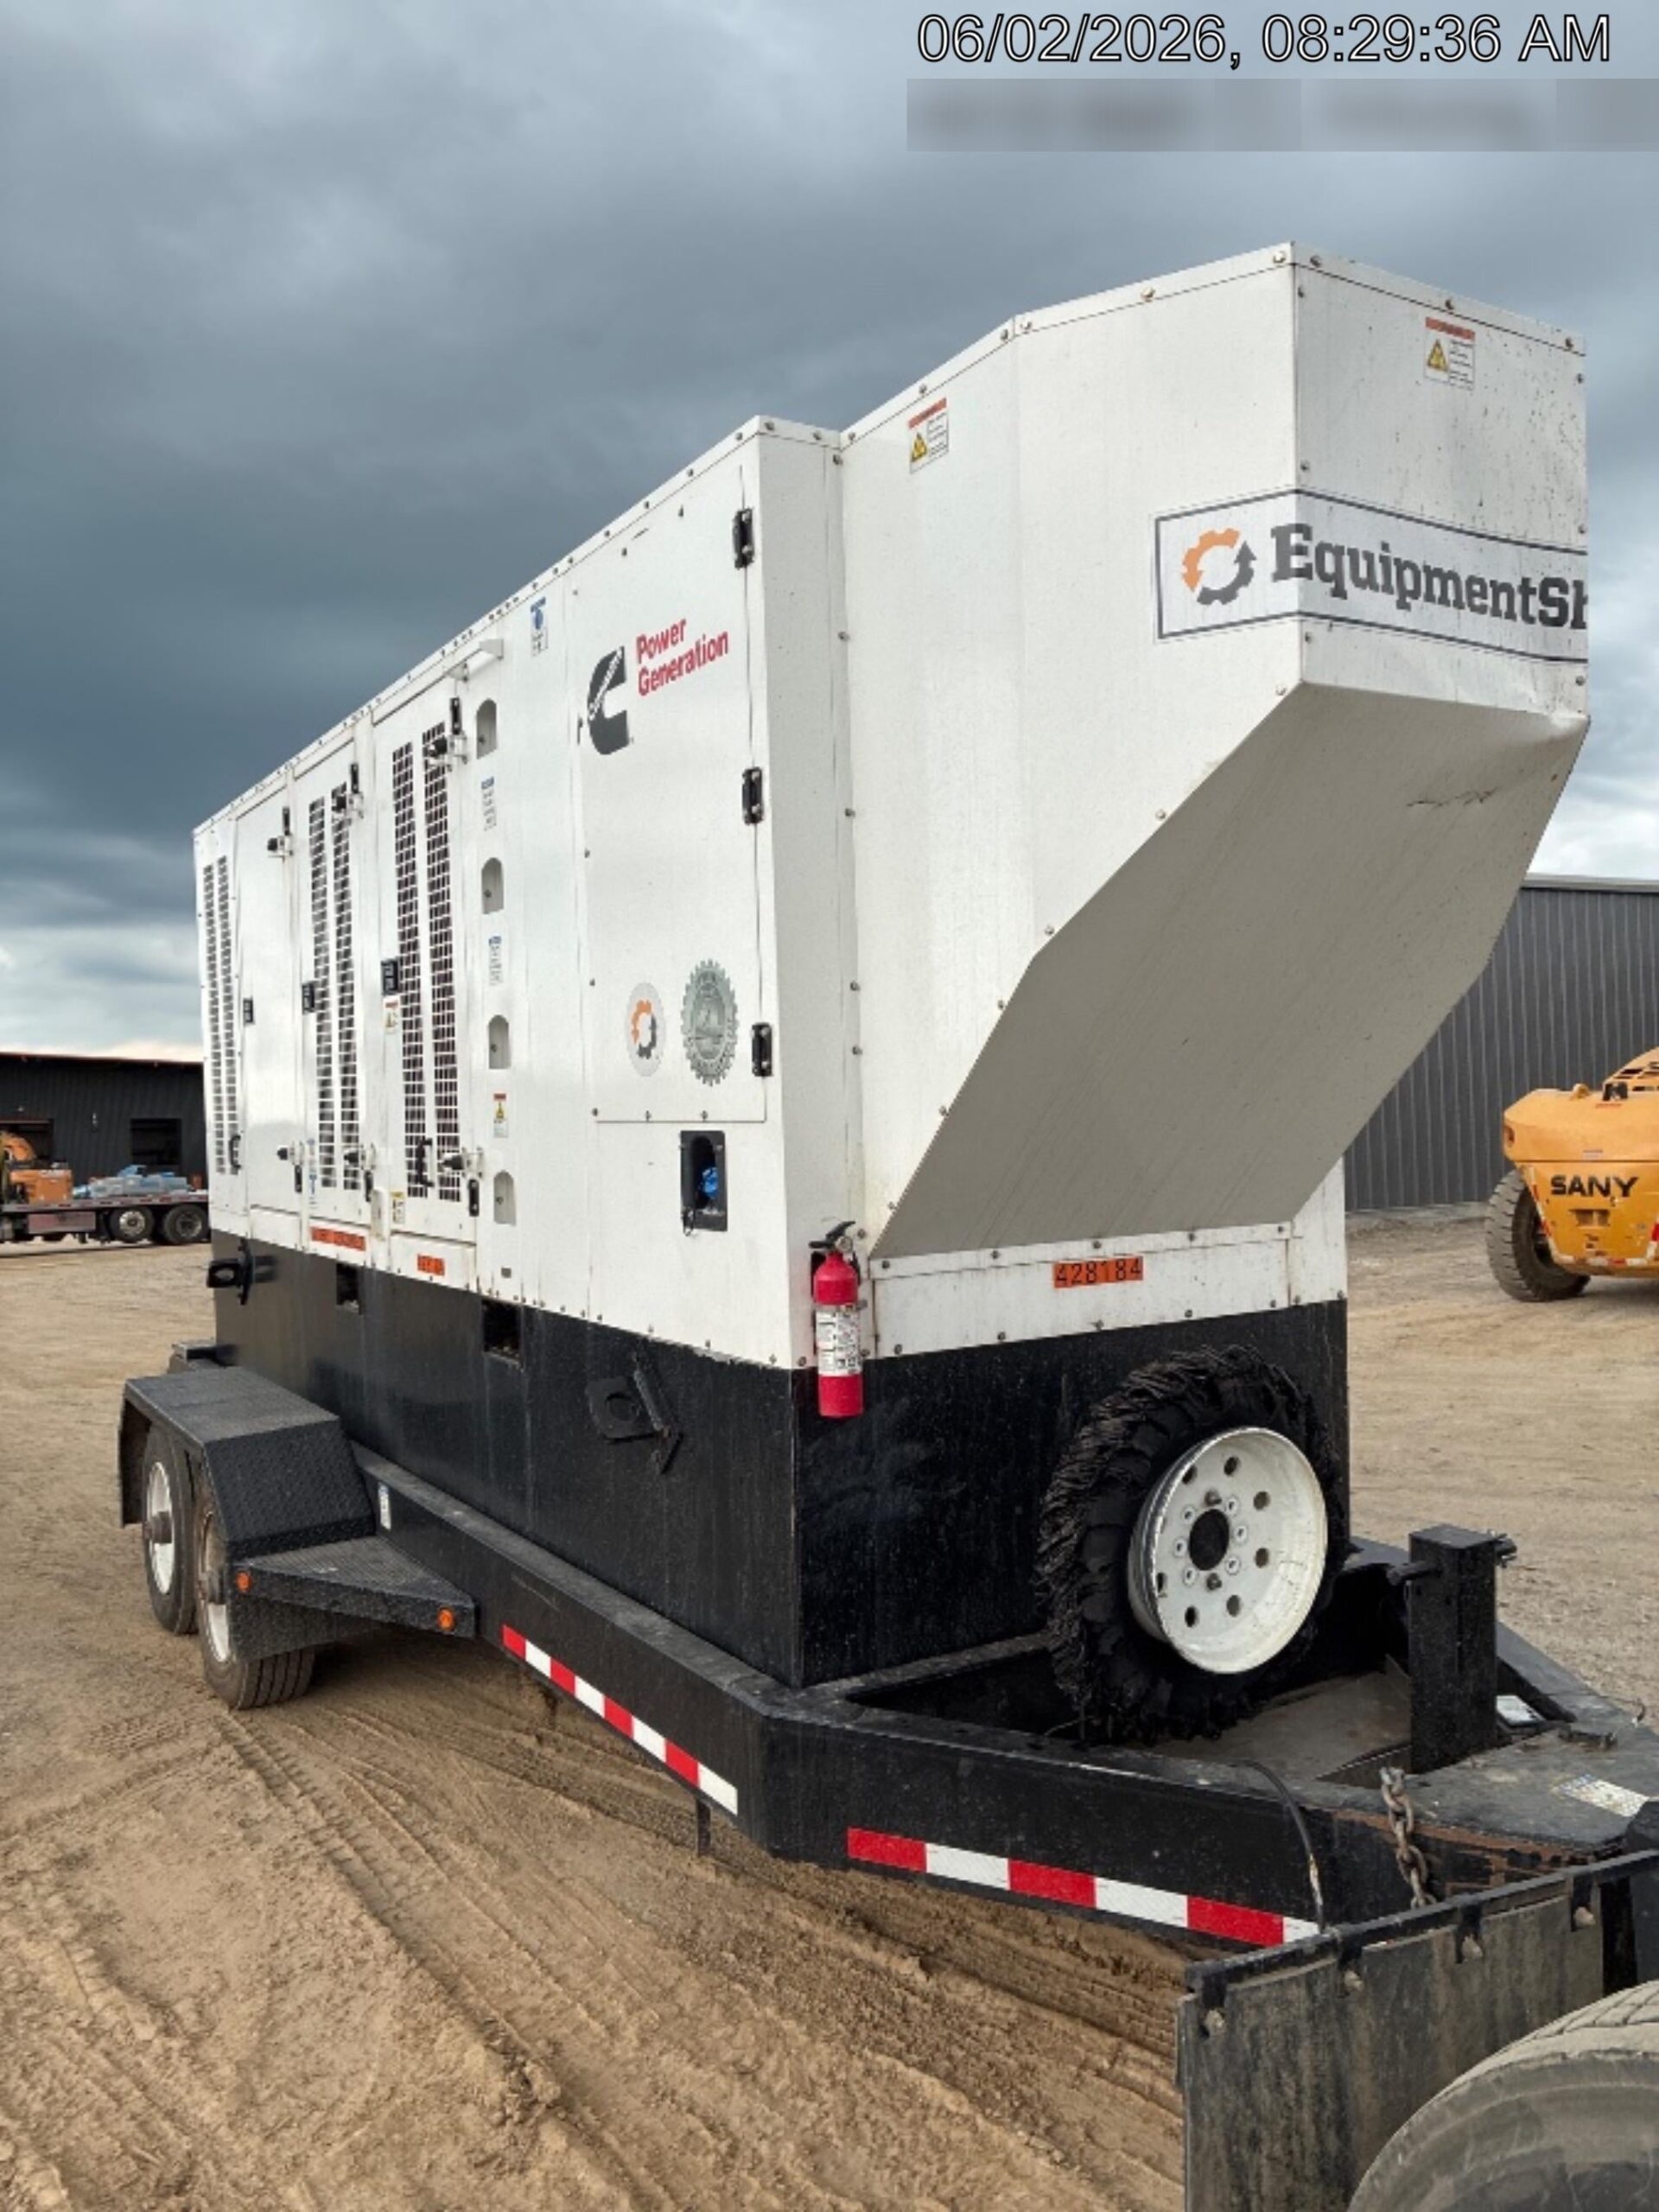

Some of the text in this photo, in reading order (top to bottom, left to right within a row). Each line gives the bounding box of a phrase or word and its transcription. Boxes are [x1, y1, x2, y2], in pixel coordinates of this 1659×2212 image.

[636, 619, 686, 664] Power
[638, 631, 728, 696] Generation
[1551, 1175, 1638, 1198] SANY
